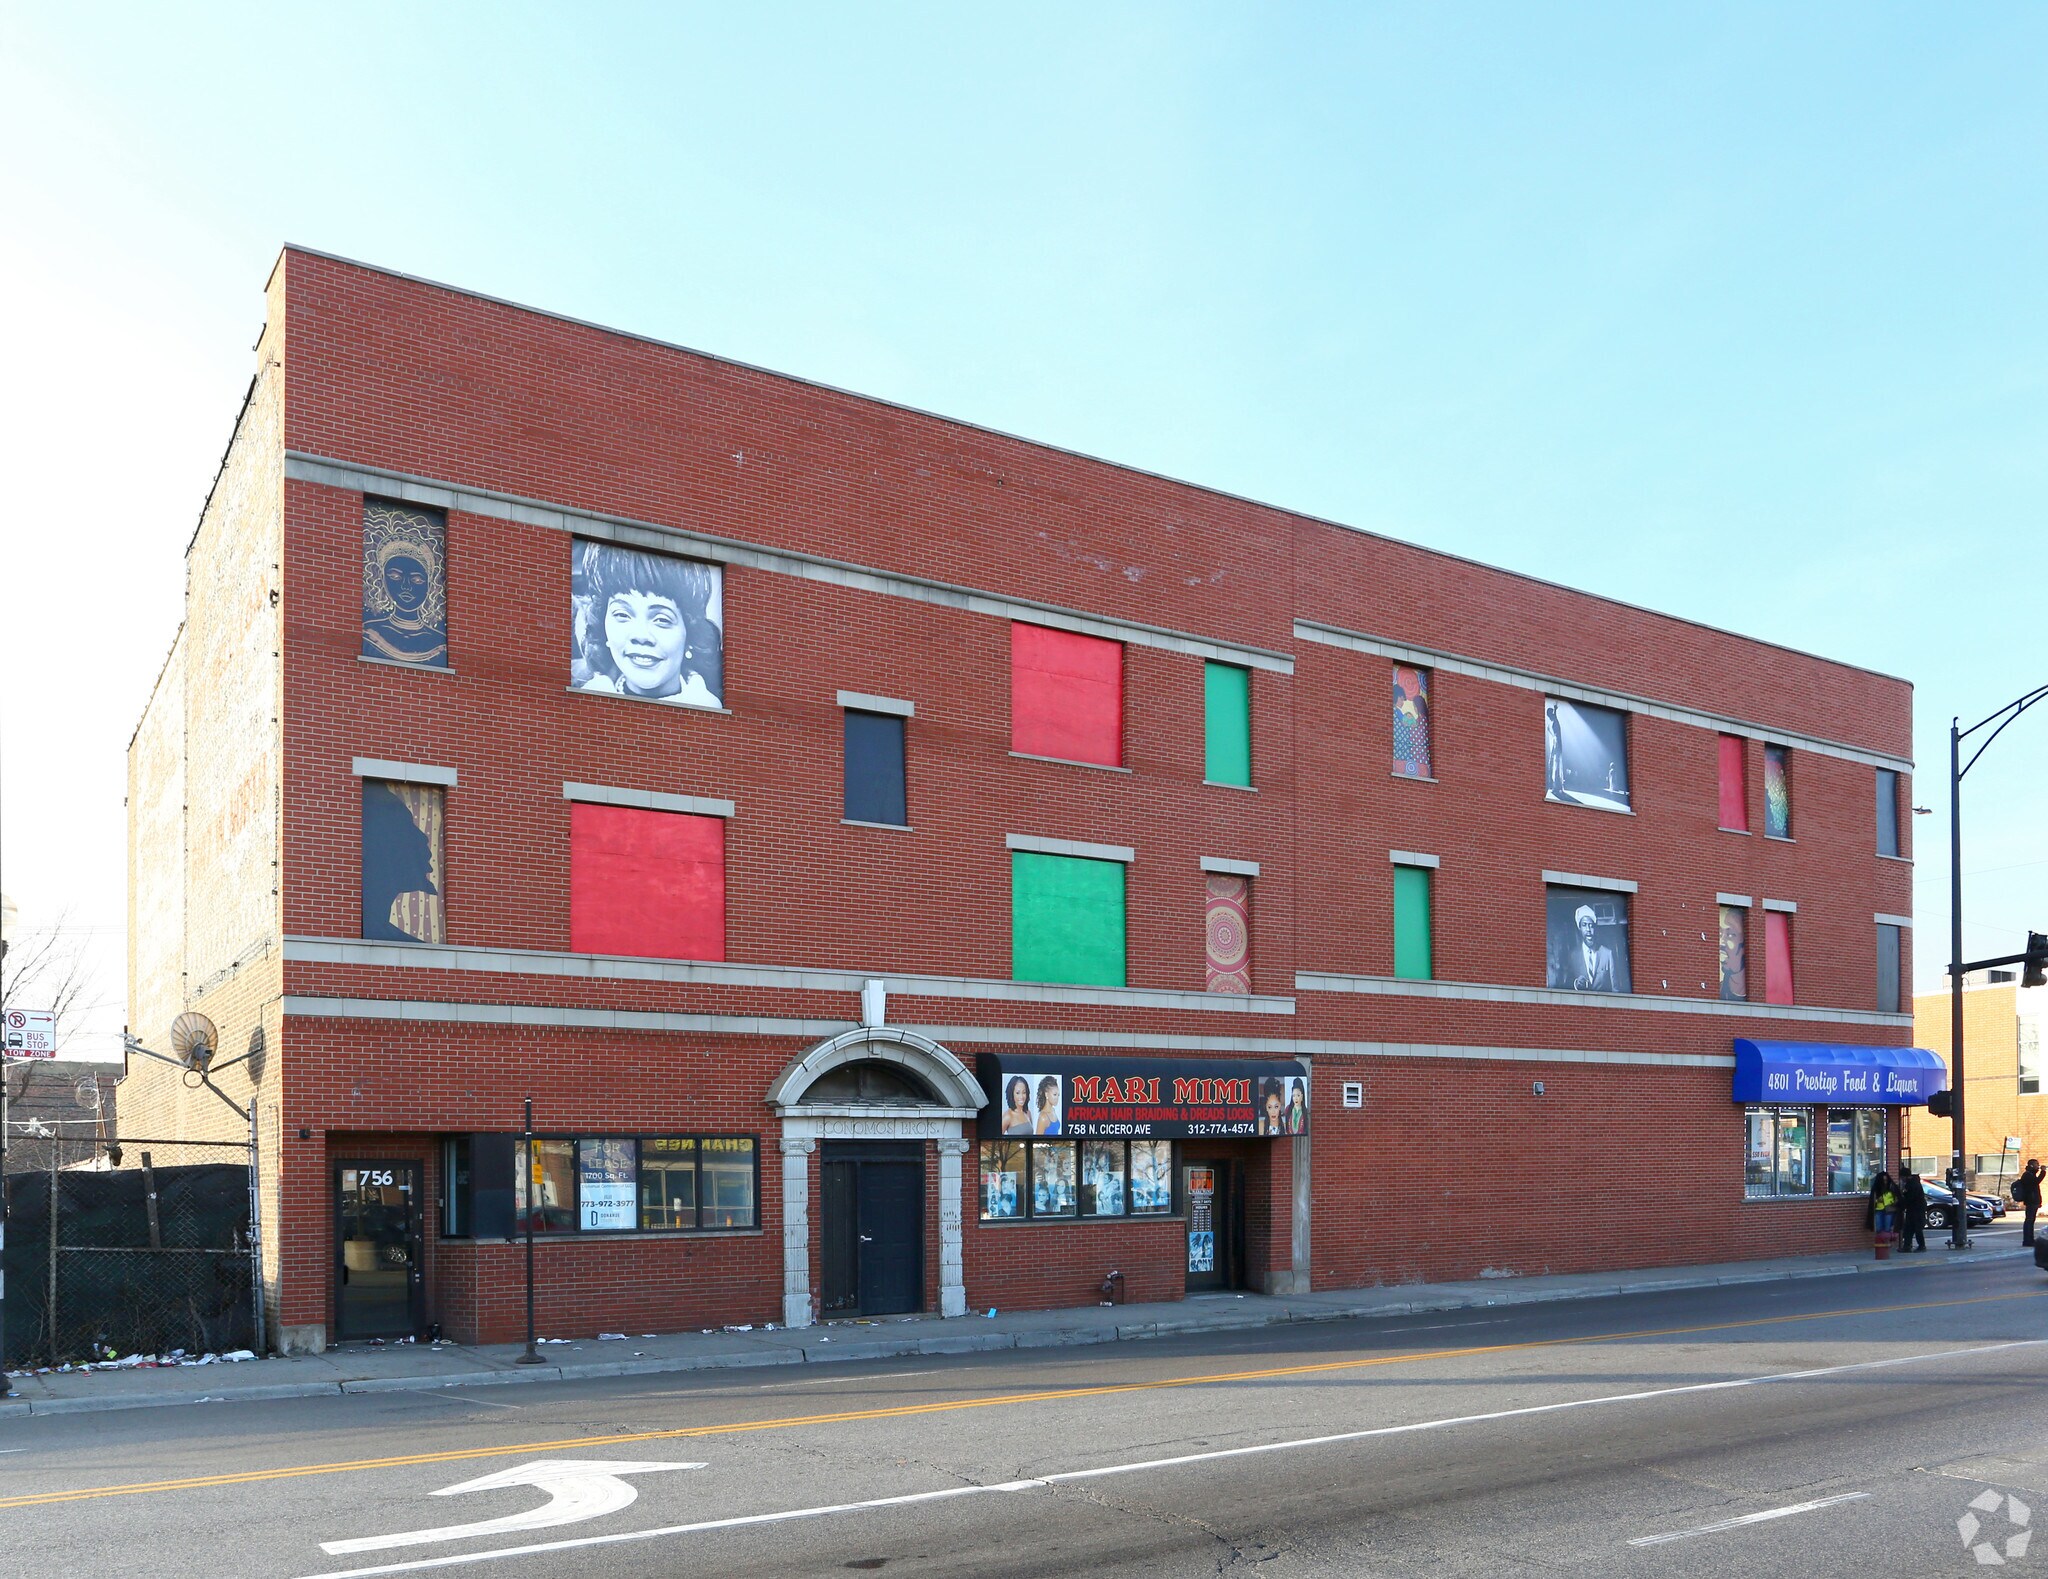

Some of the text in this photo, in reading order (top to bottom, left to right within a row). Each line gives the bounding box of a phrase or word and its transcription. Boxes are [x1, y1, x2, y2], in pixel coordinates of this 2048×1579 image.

[26, 1033, 45, 1041] BUS
[26, 1040, 49, 1049] STOP
[1768, 1068, 1918, 1098] 4801 Prestige Food & Liquor
[1071, 1075, 1251, 1105] MARI MIMI
[1067, 1106, 1255, 1121] AFRICAN HAIR BRAIDING & DREADS LOCKS
[815, 1120, 894, 1135] ECONOMOS
[1067, 1123, 1255, 1135] 758 N. CICERO AVE 312-774-4574
[595, 1142, 621, 1153] FOR
[588, 1158, 628, 1169] LEASE
[359, 1169, 394, 1186] 756
[604, 1172, 617, 1181] Sq.
[618, 1171, 629, 1179] Ft.
[1191, 1179, 1212, 1190] OPEN
